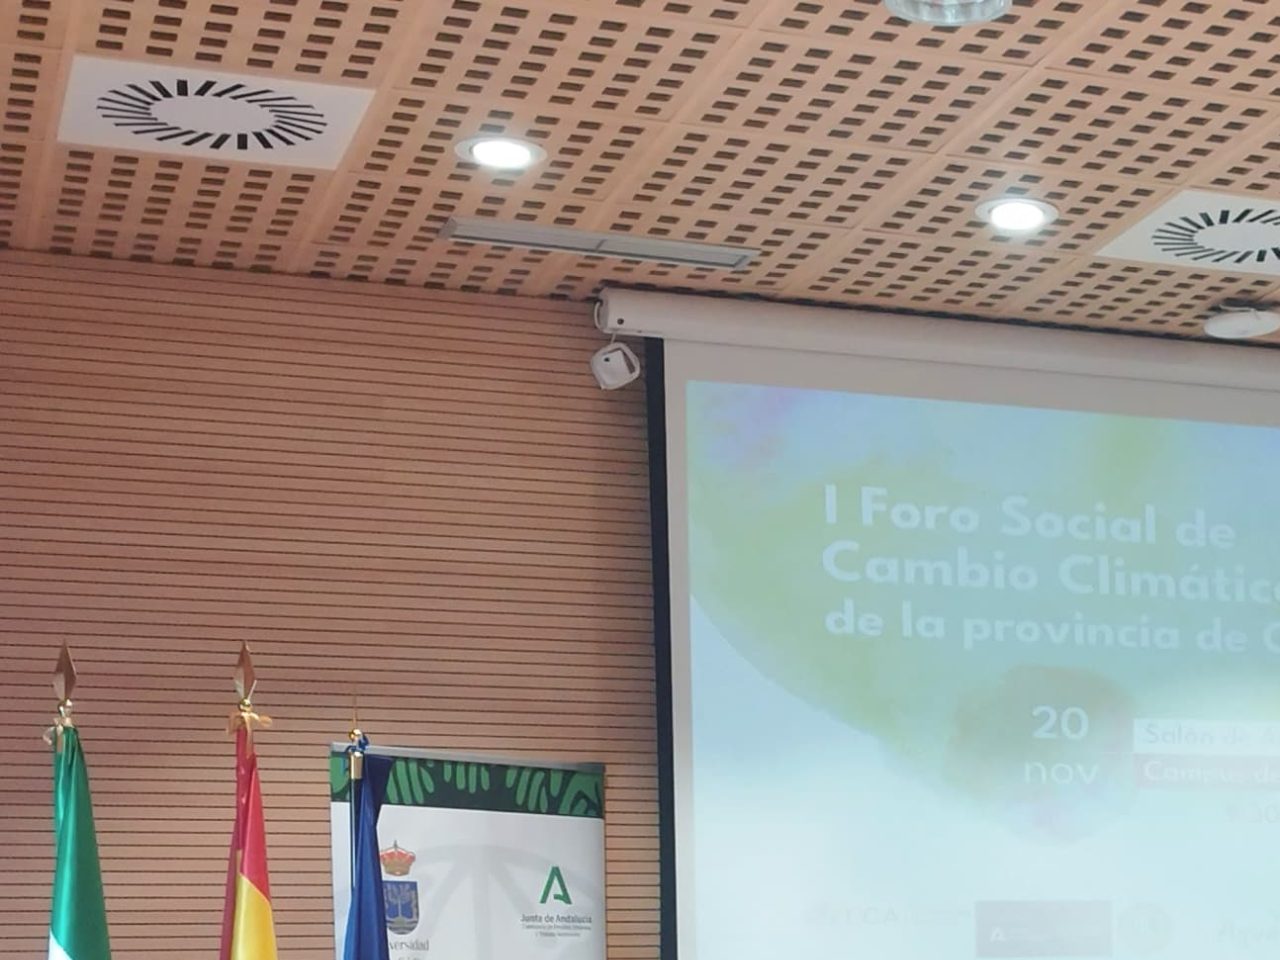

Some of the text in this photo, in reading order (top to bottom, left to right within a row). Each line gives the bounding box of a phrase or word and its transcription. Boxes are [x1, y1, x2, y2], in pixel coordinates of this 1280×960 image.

[824, 483, 1236, 550] I Foro Social de
[821, 539, 1039, 590] Cambio
[824, 597, 884, 636] de
[901, 599, 945, 639] la
[962, 610, 1180, 650] provincia
[1195, 616, 1249, 651] de
[1031, 705, 1089, 740] 20
[1023, 761, 1099, 785] nov
[520, 913, 543, 923] Junta
[544, 913, 555, 923] de
